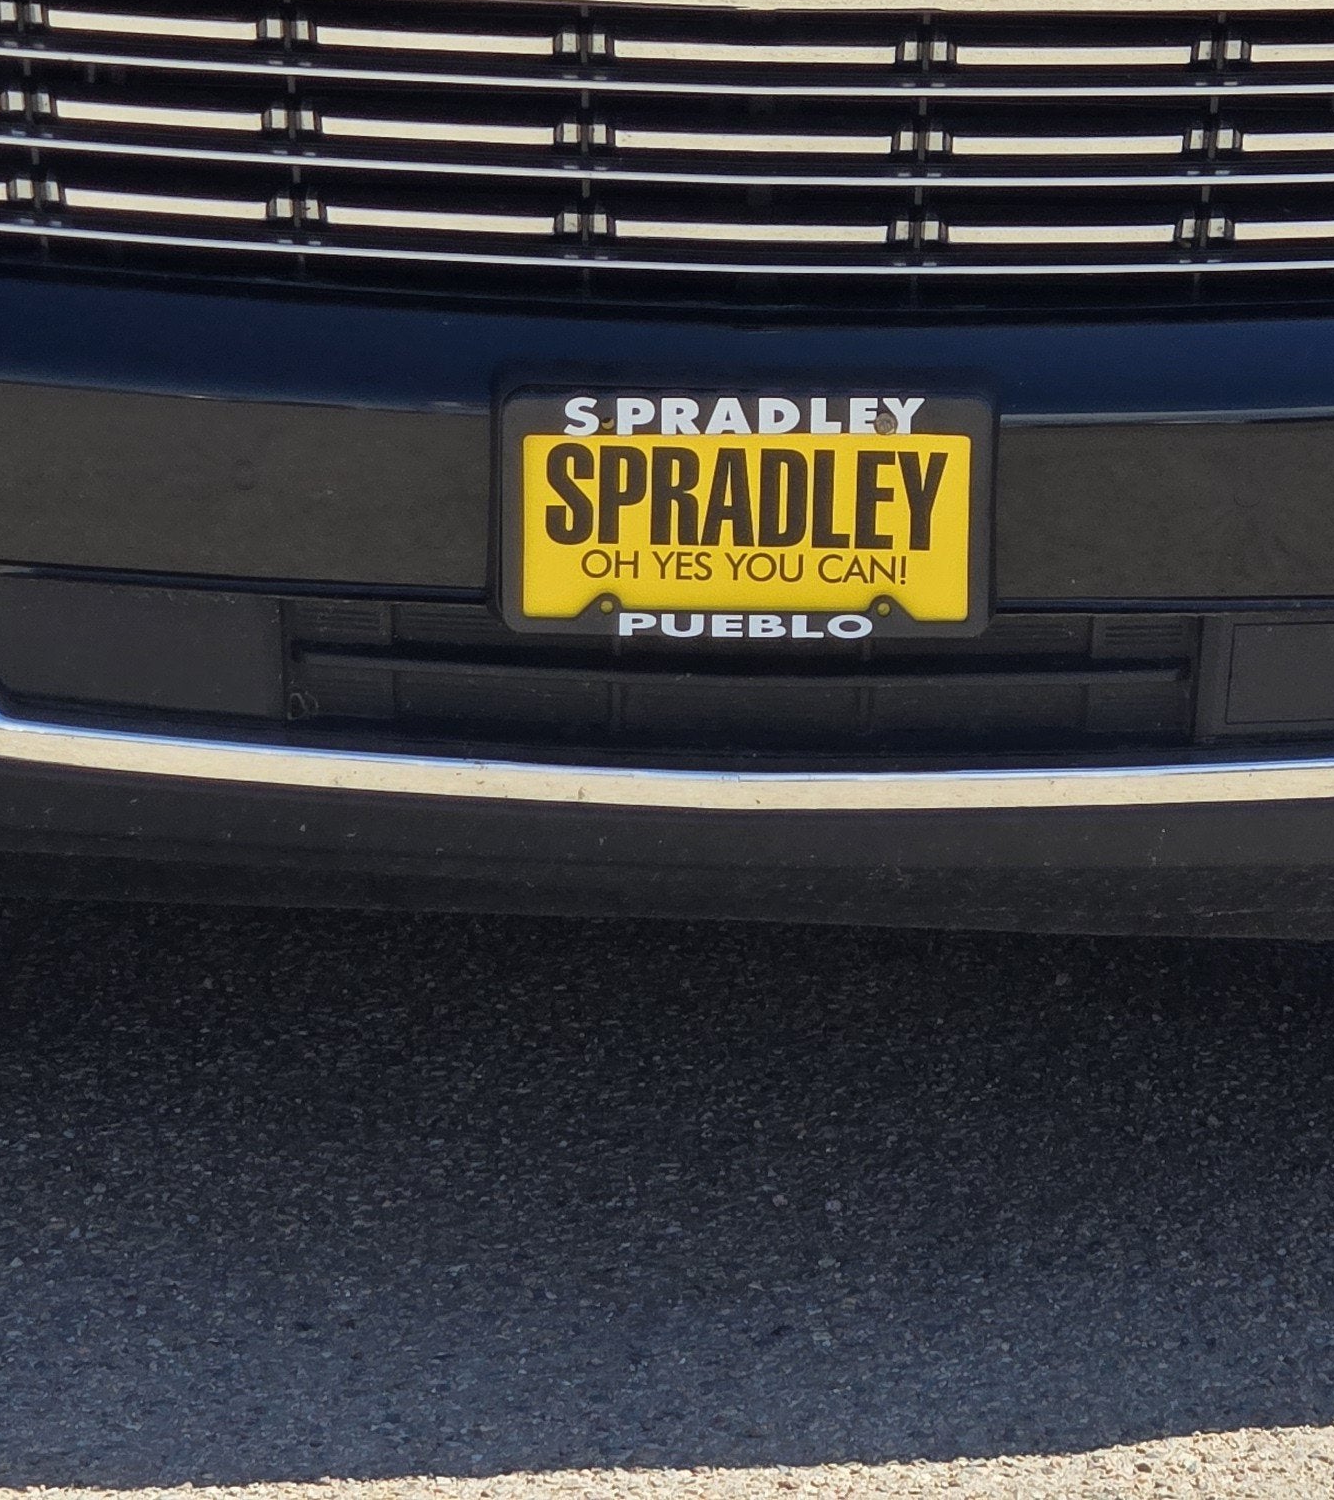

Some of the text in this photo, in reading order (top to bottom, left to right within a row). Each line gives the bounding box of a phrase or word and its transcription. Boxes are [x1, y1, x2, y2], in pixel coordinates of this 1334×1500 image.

[564, 397, 925, 436] SPRADLEY
[545, 442, 949, 551] SPRADLEY
[580, 549, 908, 585] OH YES YOU CAN!
[618, 611, 874, 640] PUEBLO
